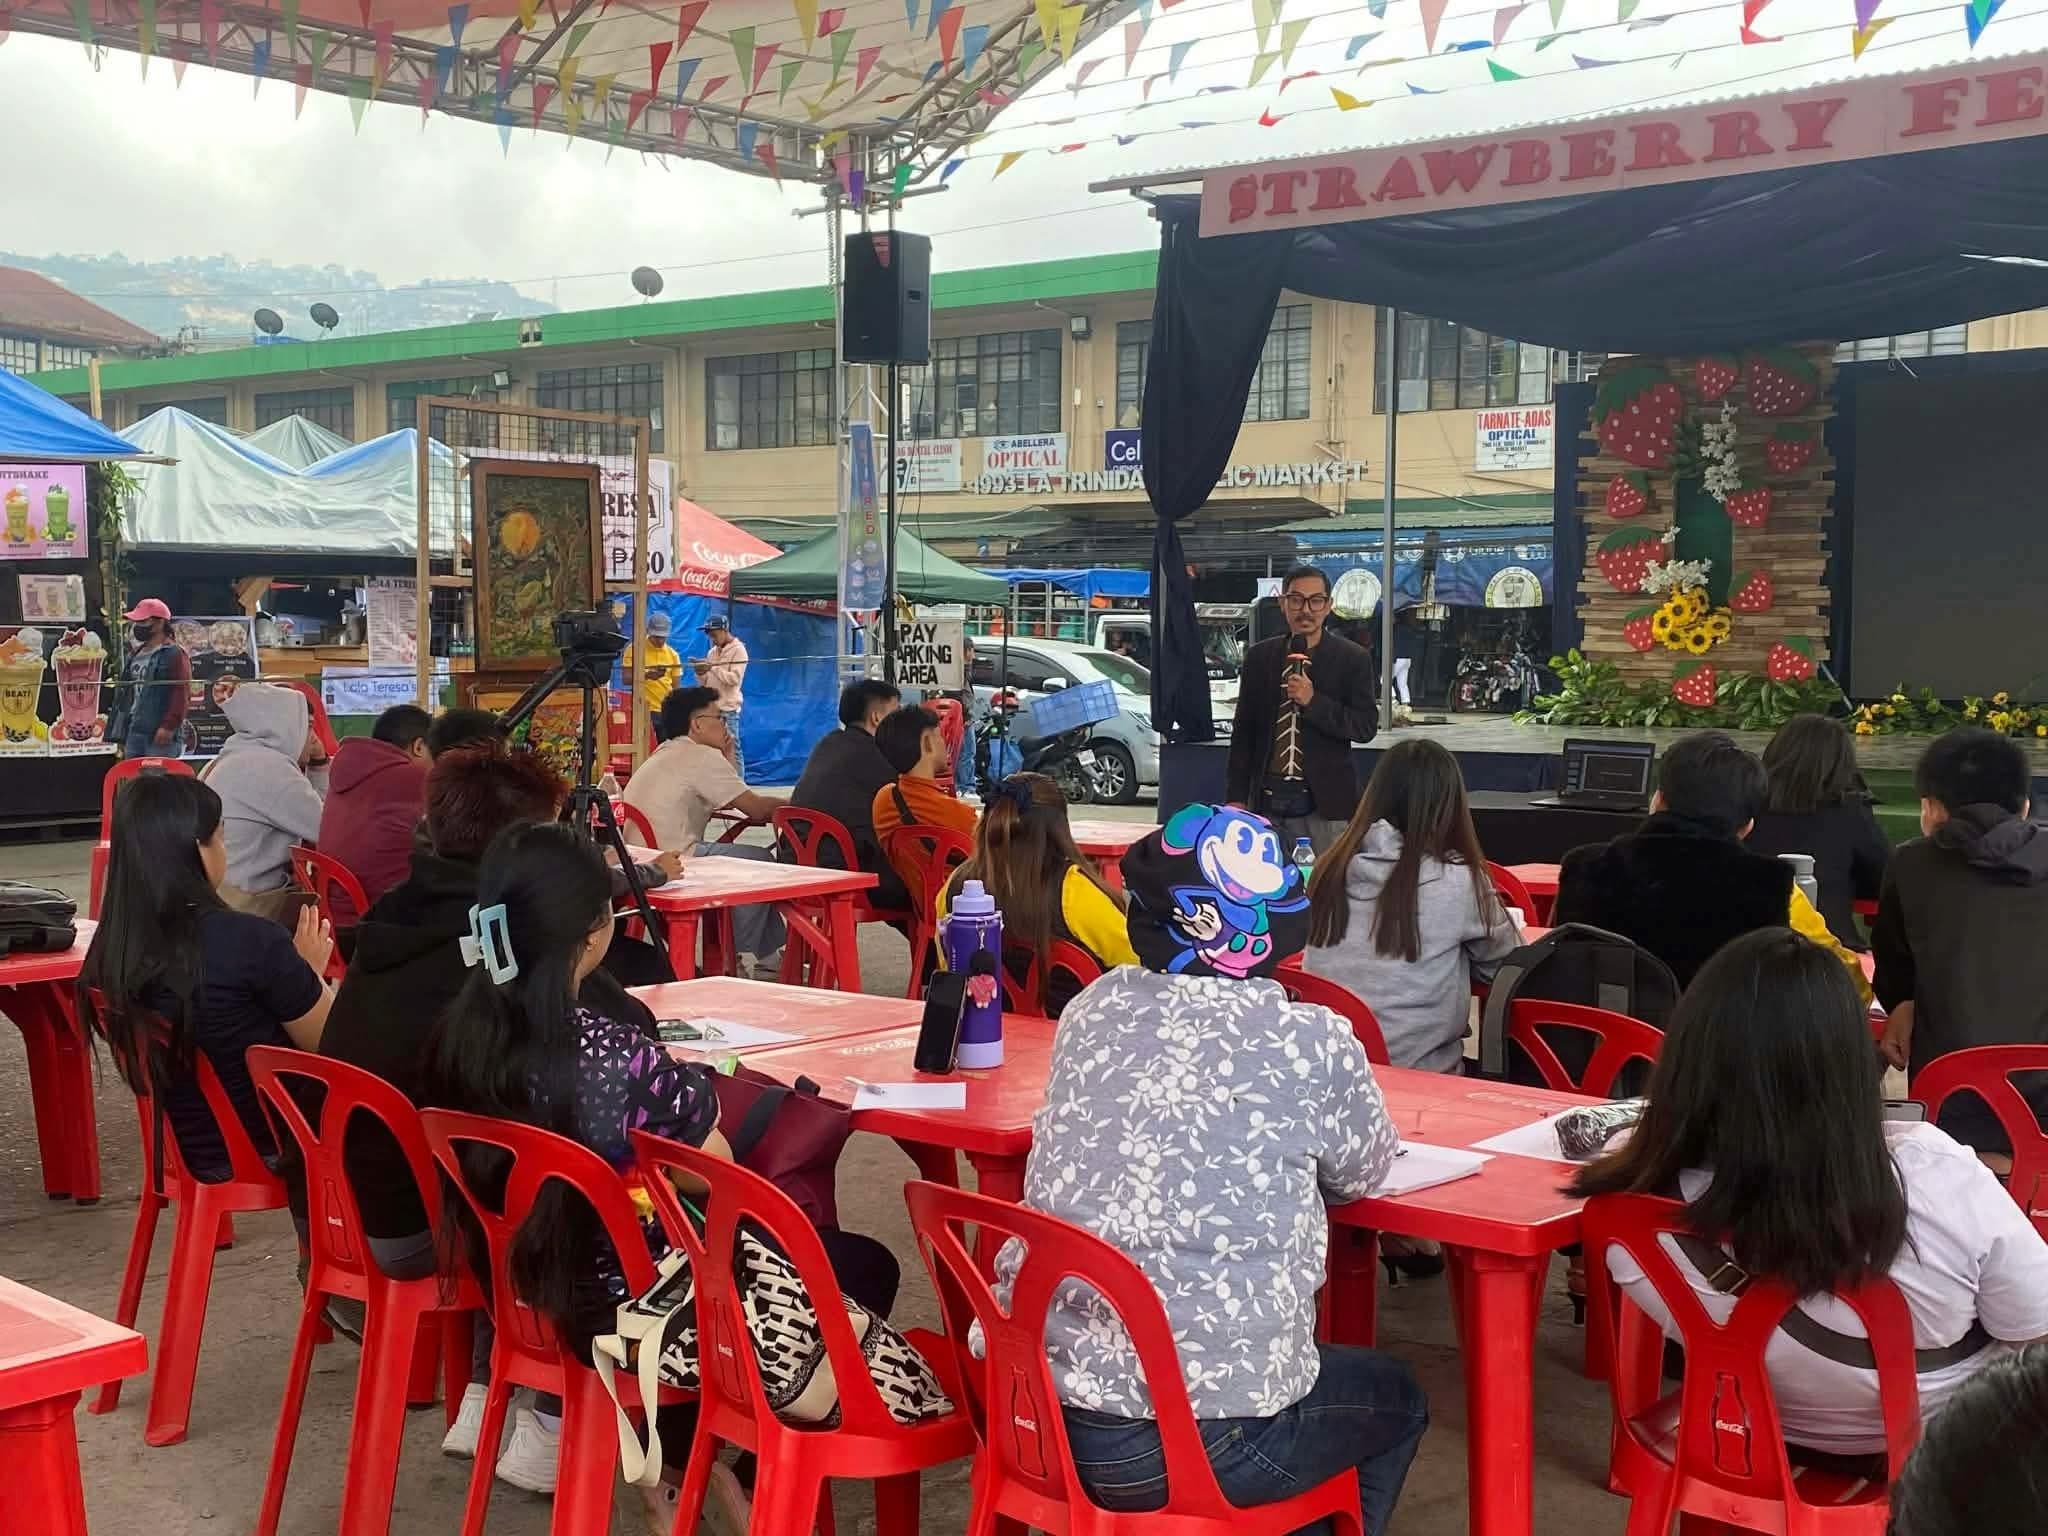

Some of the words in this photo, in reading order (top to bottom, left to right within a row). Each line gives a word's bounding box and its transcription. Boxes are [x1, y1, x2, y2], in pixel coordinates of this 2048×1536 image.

[1228, 97, 1849, 224] STRAWBERRY
[1011, 437, 1056, 449] ABELLERA
[987, 449, 1062, 469] OPTICAL
[1255, 459, 1364, 487] MARKET
[900, 623, 938, 643] PAY
[896, 644, 952, 665] ARKING
[898, 665, 938, 685] AREA
